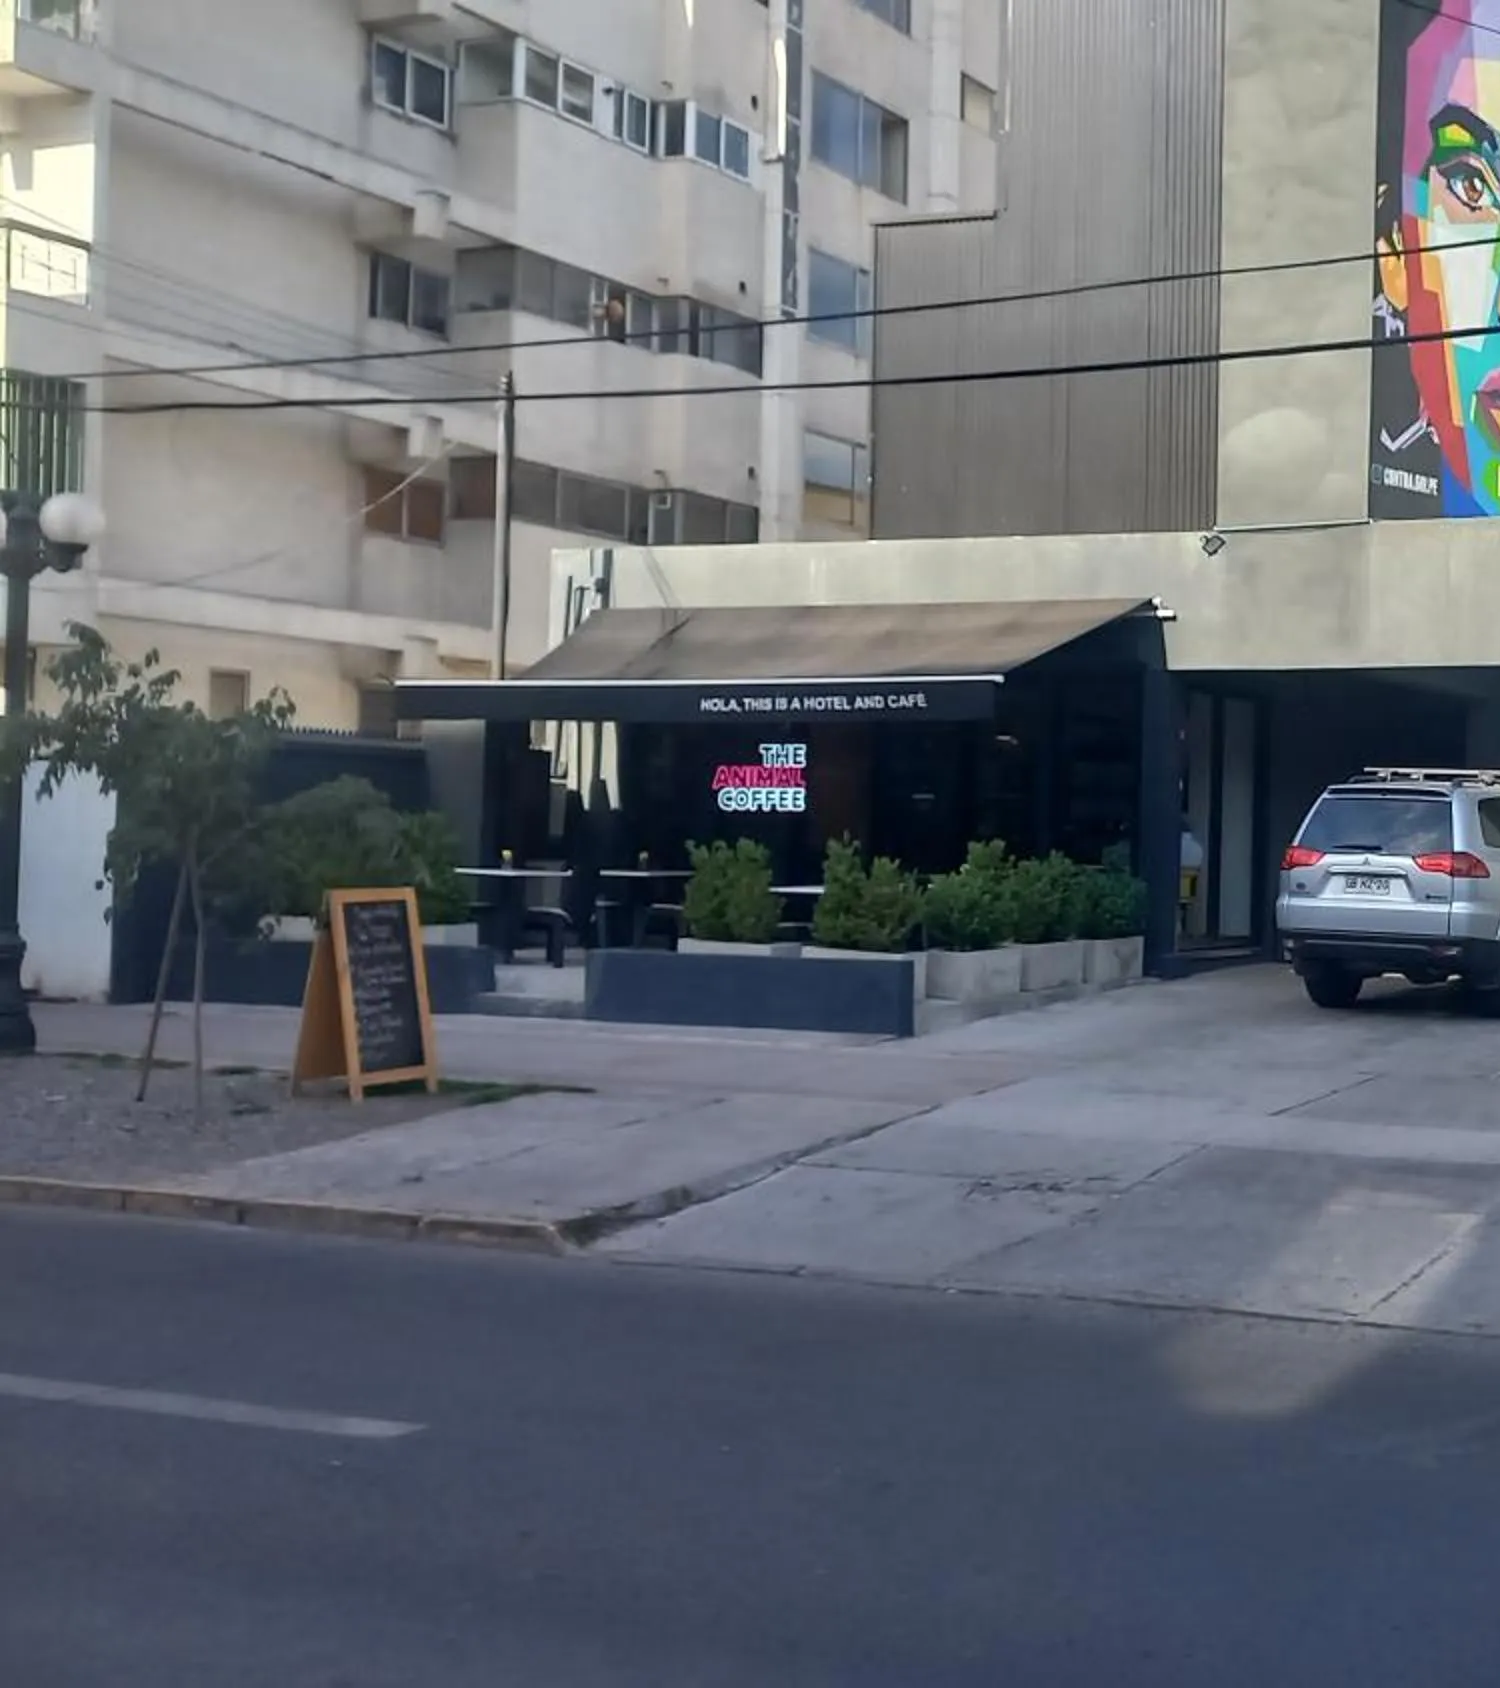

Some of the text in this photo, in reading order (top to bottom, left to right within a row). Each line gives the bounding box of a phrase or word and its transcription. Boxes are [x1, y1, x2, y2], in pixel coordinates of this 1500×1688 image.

[701, 697, 742, 712] HOLA,
[742, 697, 772, 712] THIS
[775, 697, 788, 710] IS
[790, 697, 801, 710] A
[803, 696, 851, 711] HOTEL
[854, 695, 885, 709] AND
[759, 744, 807, 768] THE
[712, 765, 807, 789] ANIMAL
[718, 787, 806, 812] COFFEE
